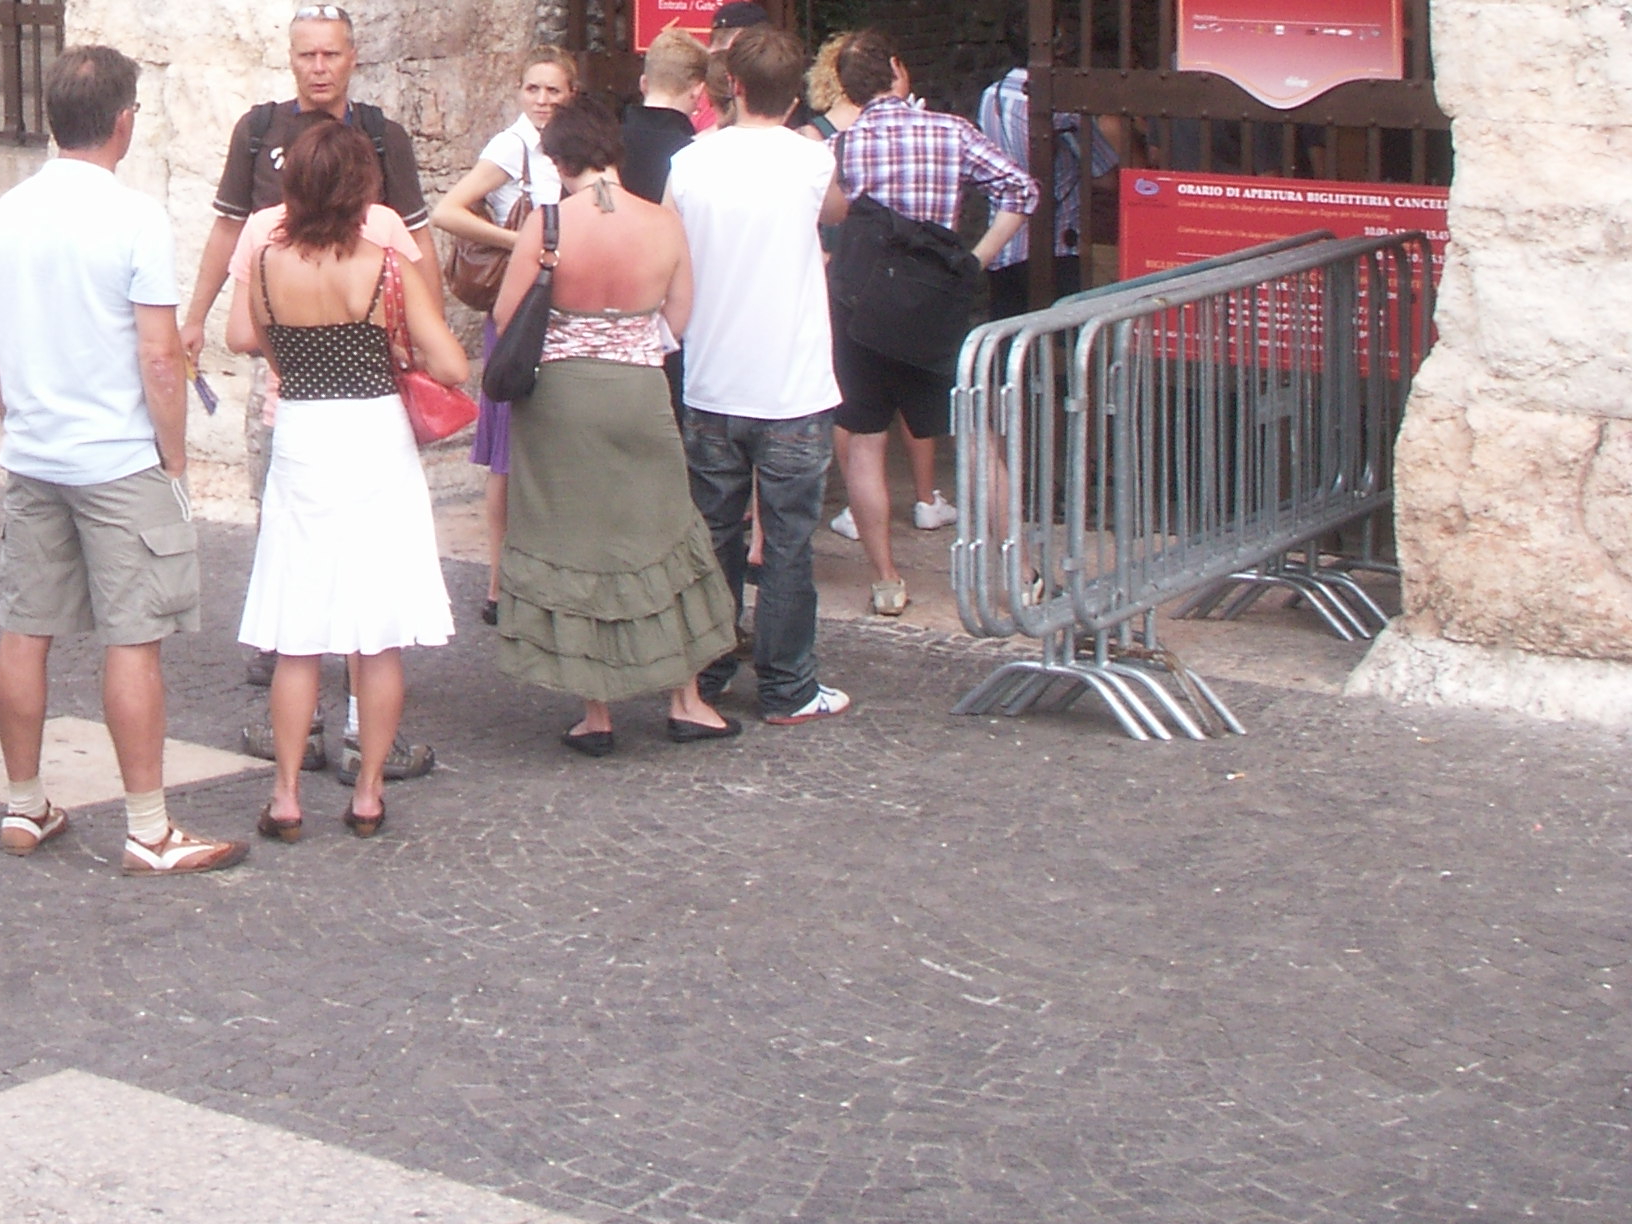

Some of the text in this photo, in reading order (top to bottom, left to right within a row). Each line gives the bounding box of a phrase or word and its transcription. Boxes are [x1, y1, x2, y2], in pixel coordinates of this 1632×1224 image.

[1178, 184, 1223, 196] ORARIO
[1226, 187, 1240, 197] DI
[1243, 188, 1303, 202] APERTURA
[1307, 192, 1391, 207] BIGLIETTERIA
